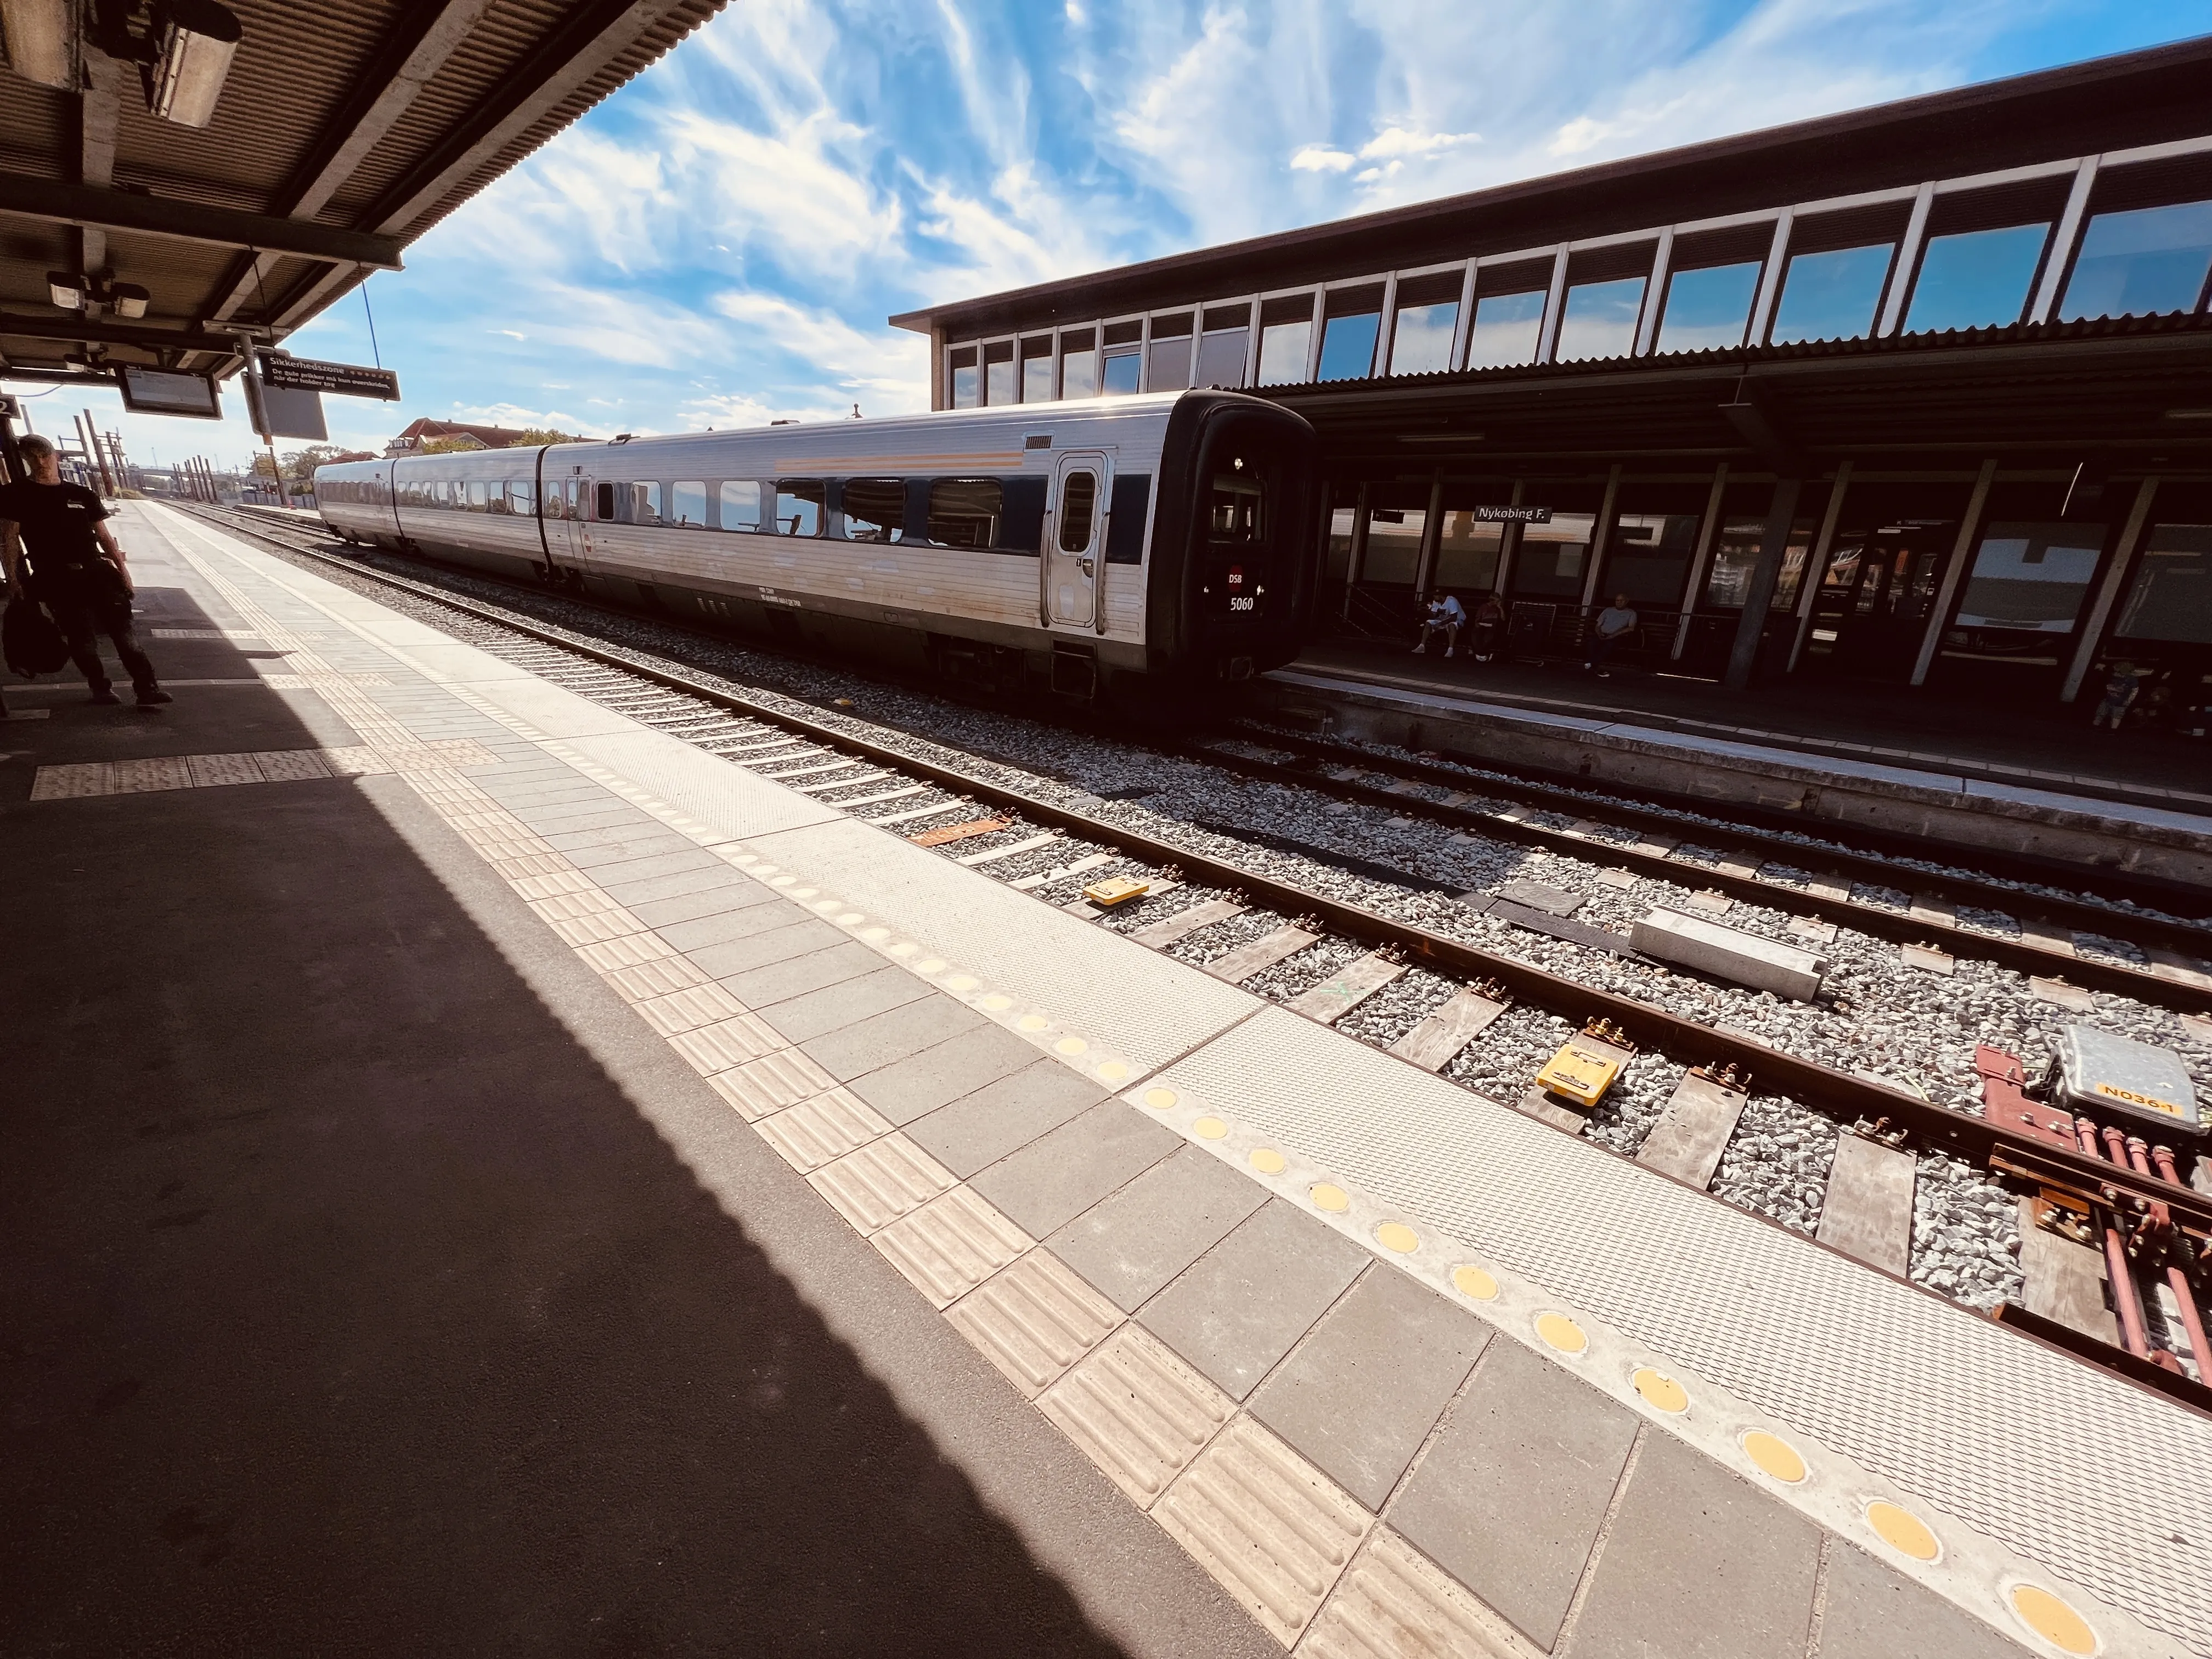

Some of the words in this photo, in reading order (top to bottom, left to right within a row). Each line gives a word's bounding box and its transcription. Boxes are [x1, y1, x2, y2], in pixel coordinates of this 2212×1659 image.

[269, 357, 344, 374] Sikkerhedszone
[1479, 508, 1533, 520] Nykøbing
[1536, 509, 1544, 519] F.
[1229, 574, 1242, 583] DSB
[1231, 597, 1254, 611] 5060
